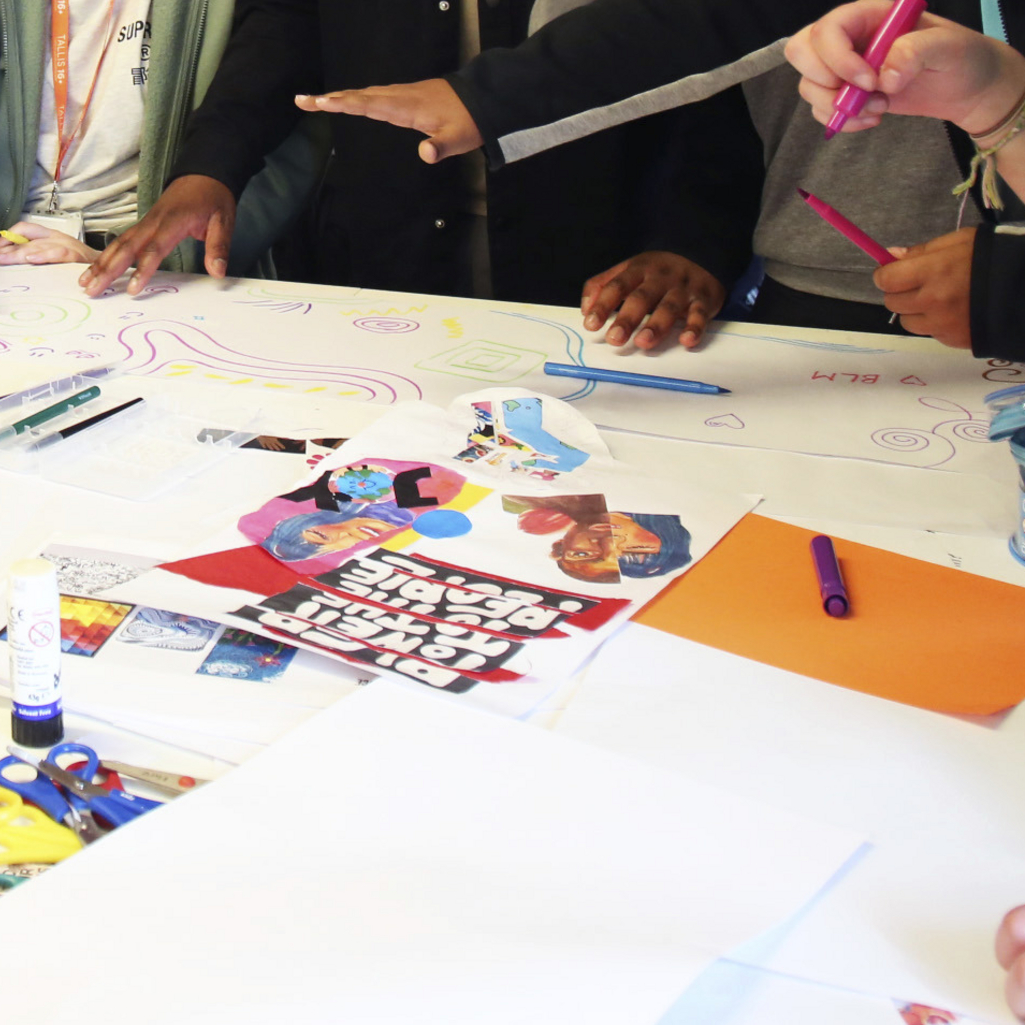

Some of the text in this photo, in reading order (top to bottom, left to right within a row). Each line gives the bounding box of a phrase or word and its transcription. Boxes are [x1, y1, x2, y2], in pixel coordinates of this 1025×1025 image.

[57, 0, 66, 15] 16+
[57, 34, 66, 85] TALLIS 16+
[811, 370, 879, 385] BLM
